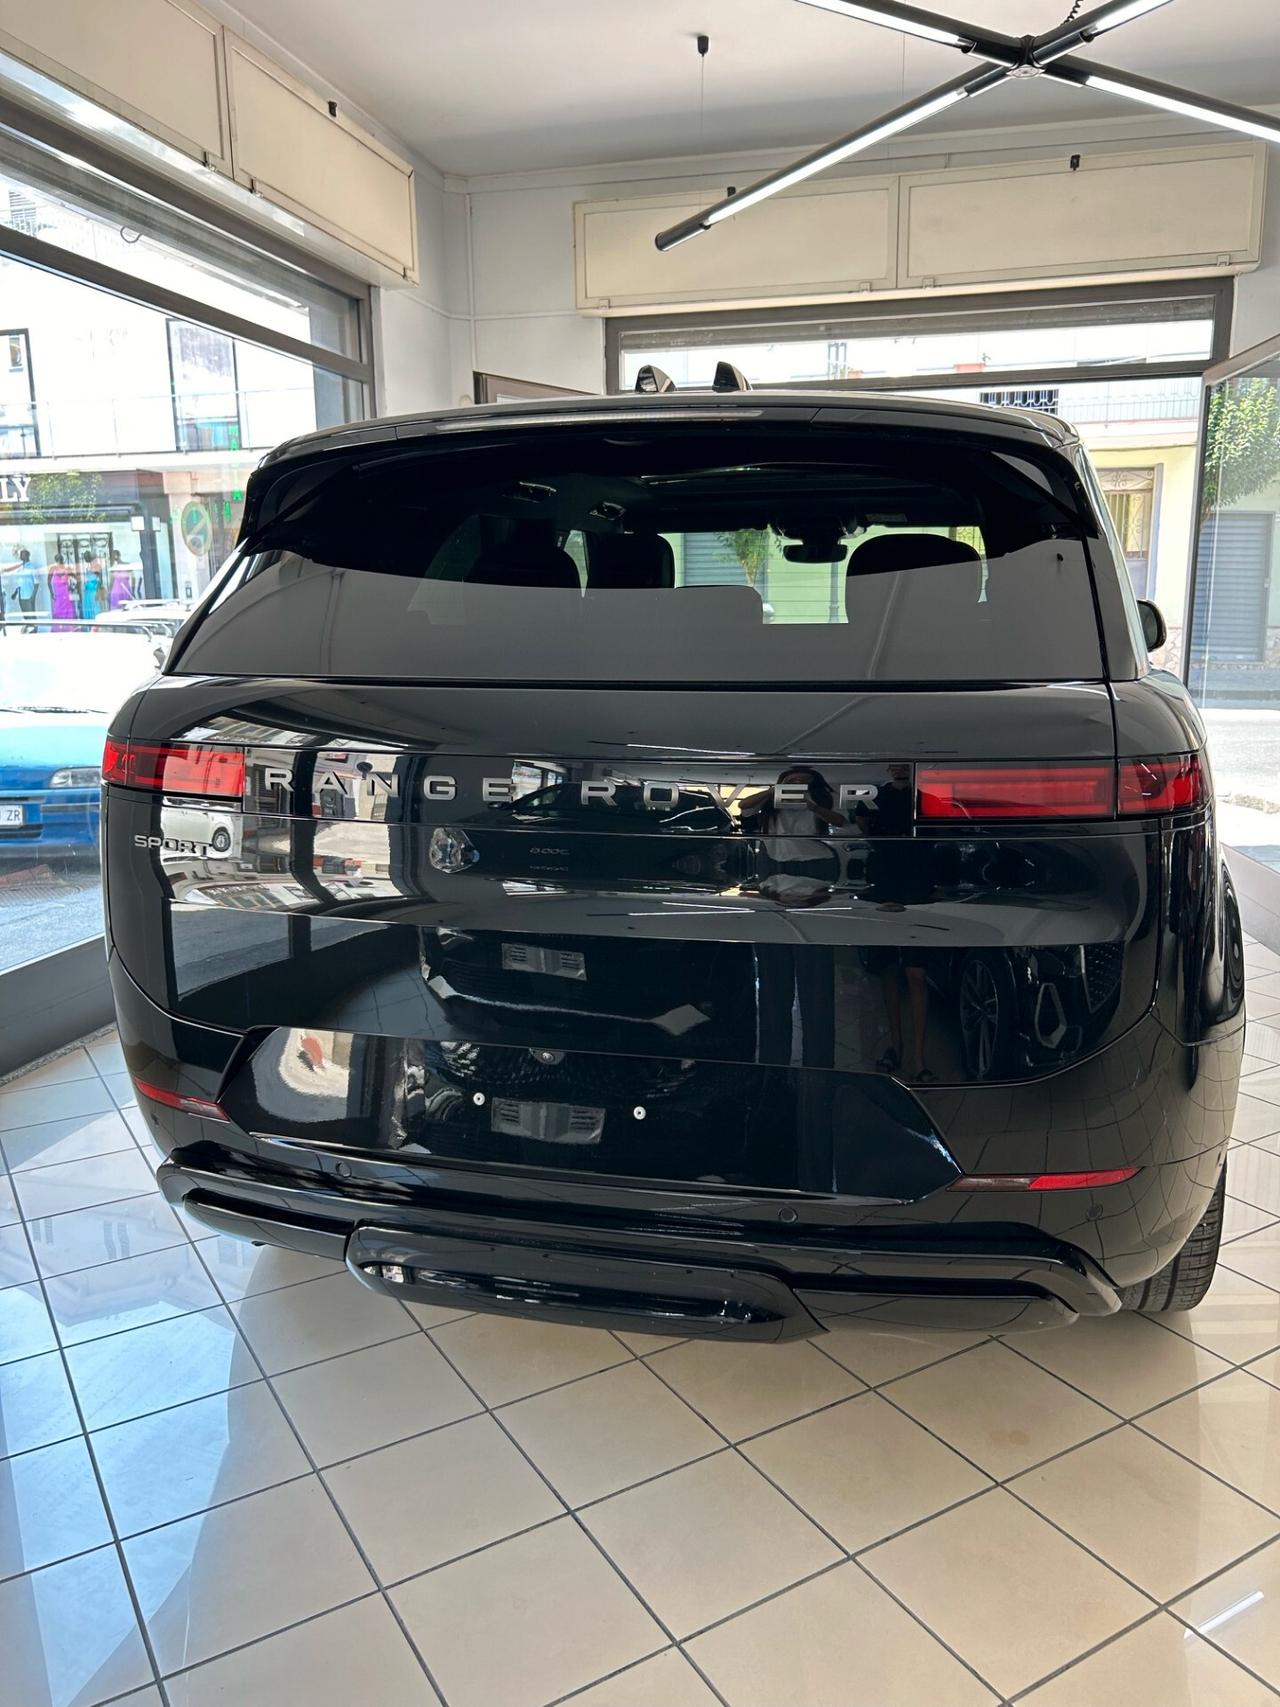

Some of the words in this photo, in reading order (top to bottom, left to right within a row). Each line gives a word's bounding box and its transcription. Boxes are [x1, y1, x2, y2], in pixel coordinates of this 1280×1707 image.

[264, 767, 515, 802] RANGE
[580, 780, 880, 811] ROVER
[6, 809, 21, 822] ZR
[134, 834, 210, 858] SPORT
